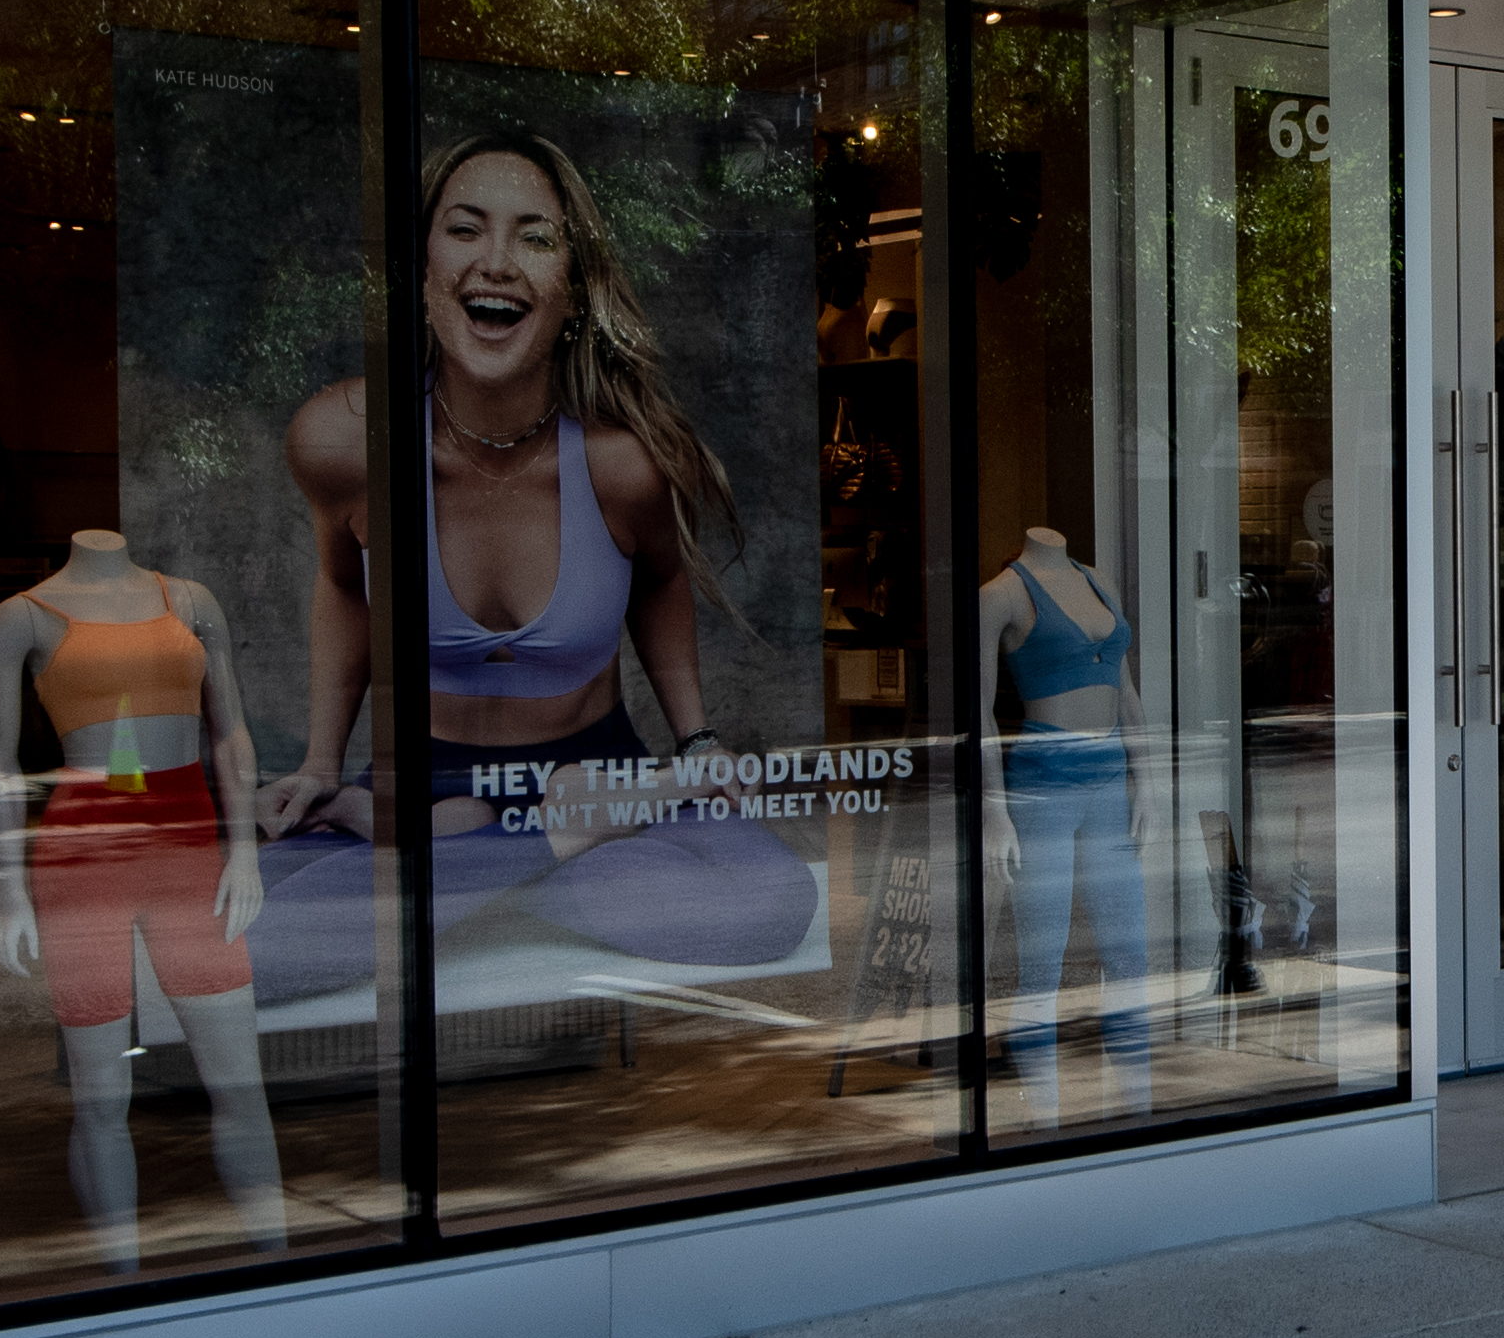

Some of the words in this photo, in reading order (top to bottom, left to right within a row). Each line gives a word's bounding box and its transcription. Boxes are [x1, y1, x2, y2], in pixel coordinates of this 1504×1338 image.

[154, 69, 197, 87] KATE
[201, 73, 275, 93] HUDSON
[472, 761, 566, 803] HEY,
[581, 756, 660, 792] THE
[672, 748, 914, 787] WOODLANDS
[501, 804, 595, 833] CAN'T
[607, 799, 684, 827] WAIT
[693, 796, 730, 822] TO
[740, 793, 813, 820] MEET
[825, 789, 891, 815] YOU.
